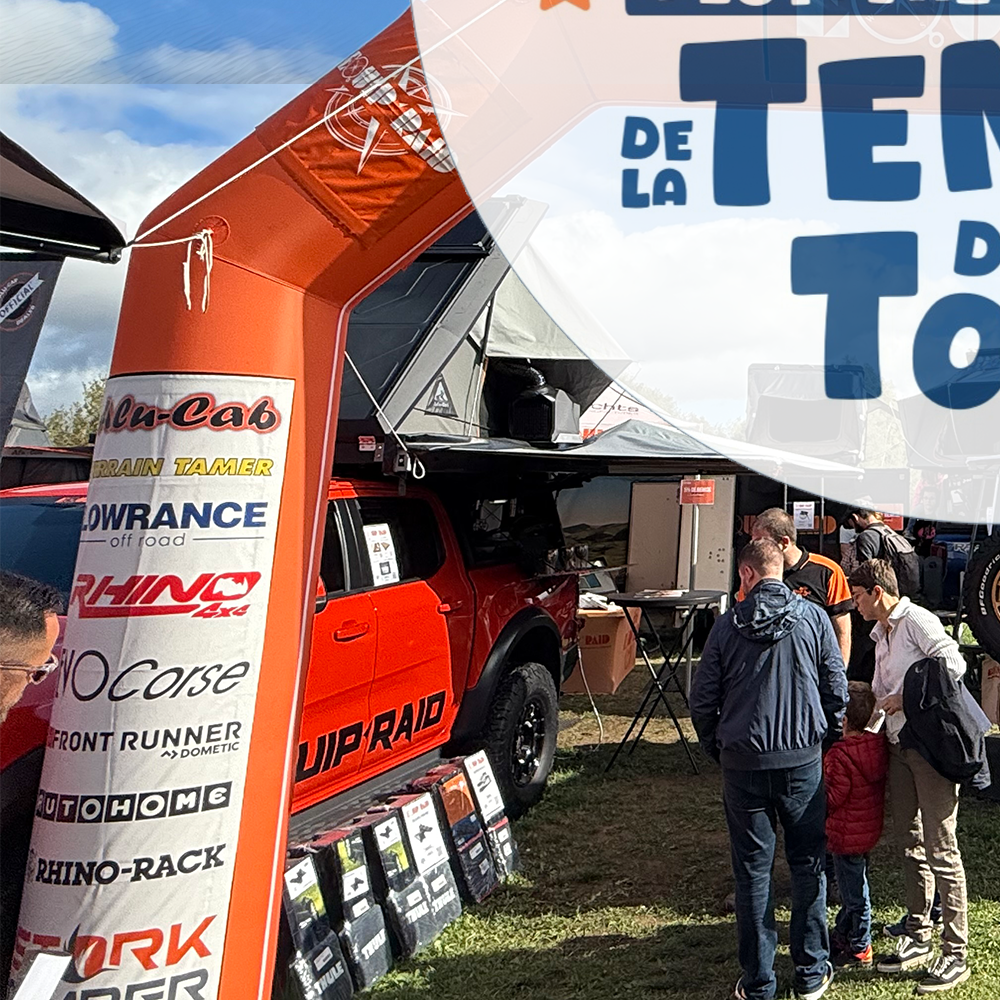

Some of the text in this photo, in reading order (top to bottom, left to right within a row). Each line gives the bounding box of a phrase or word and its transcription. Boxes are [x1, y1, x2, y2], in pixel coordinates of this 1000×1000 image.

[0, 284, 35, 318] OFFICIAL
[92, 457, 274, 477] RRAIN TAMER
[110, 533, 186, 548] off road
[69, 571, 262, 619] RHINO
[191, 602, 251, 619] 4x4
[52, 721, 243, 752] FRONT RUNNER
[180, 742, 240, 759] DOMETIC
[35, 844, 227, 886] RHINO-RACK
[313, 960, 345, 996] THULE
